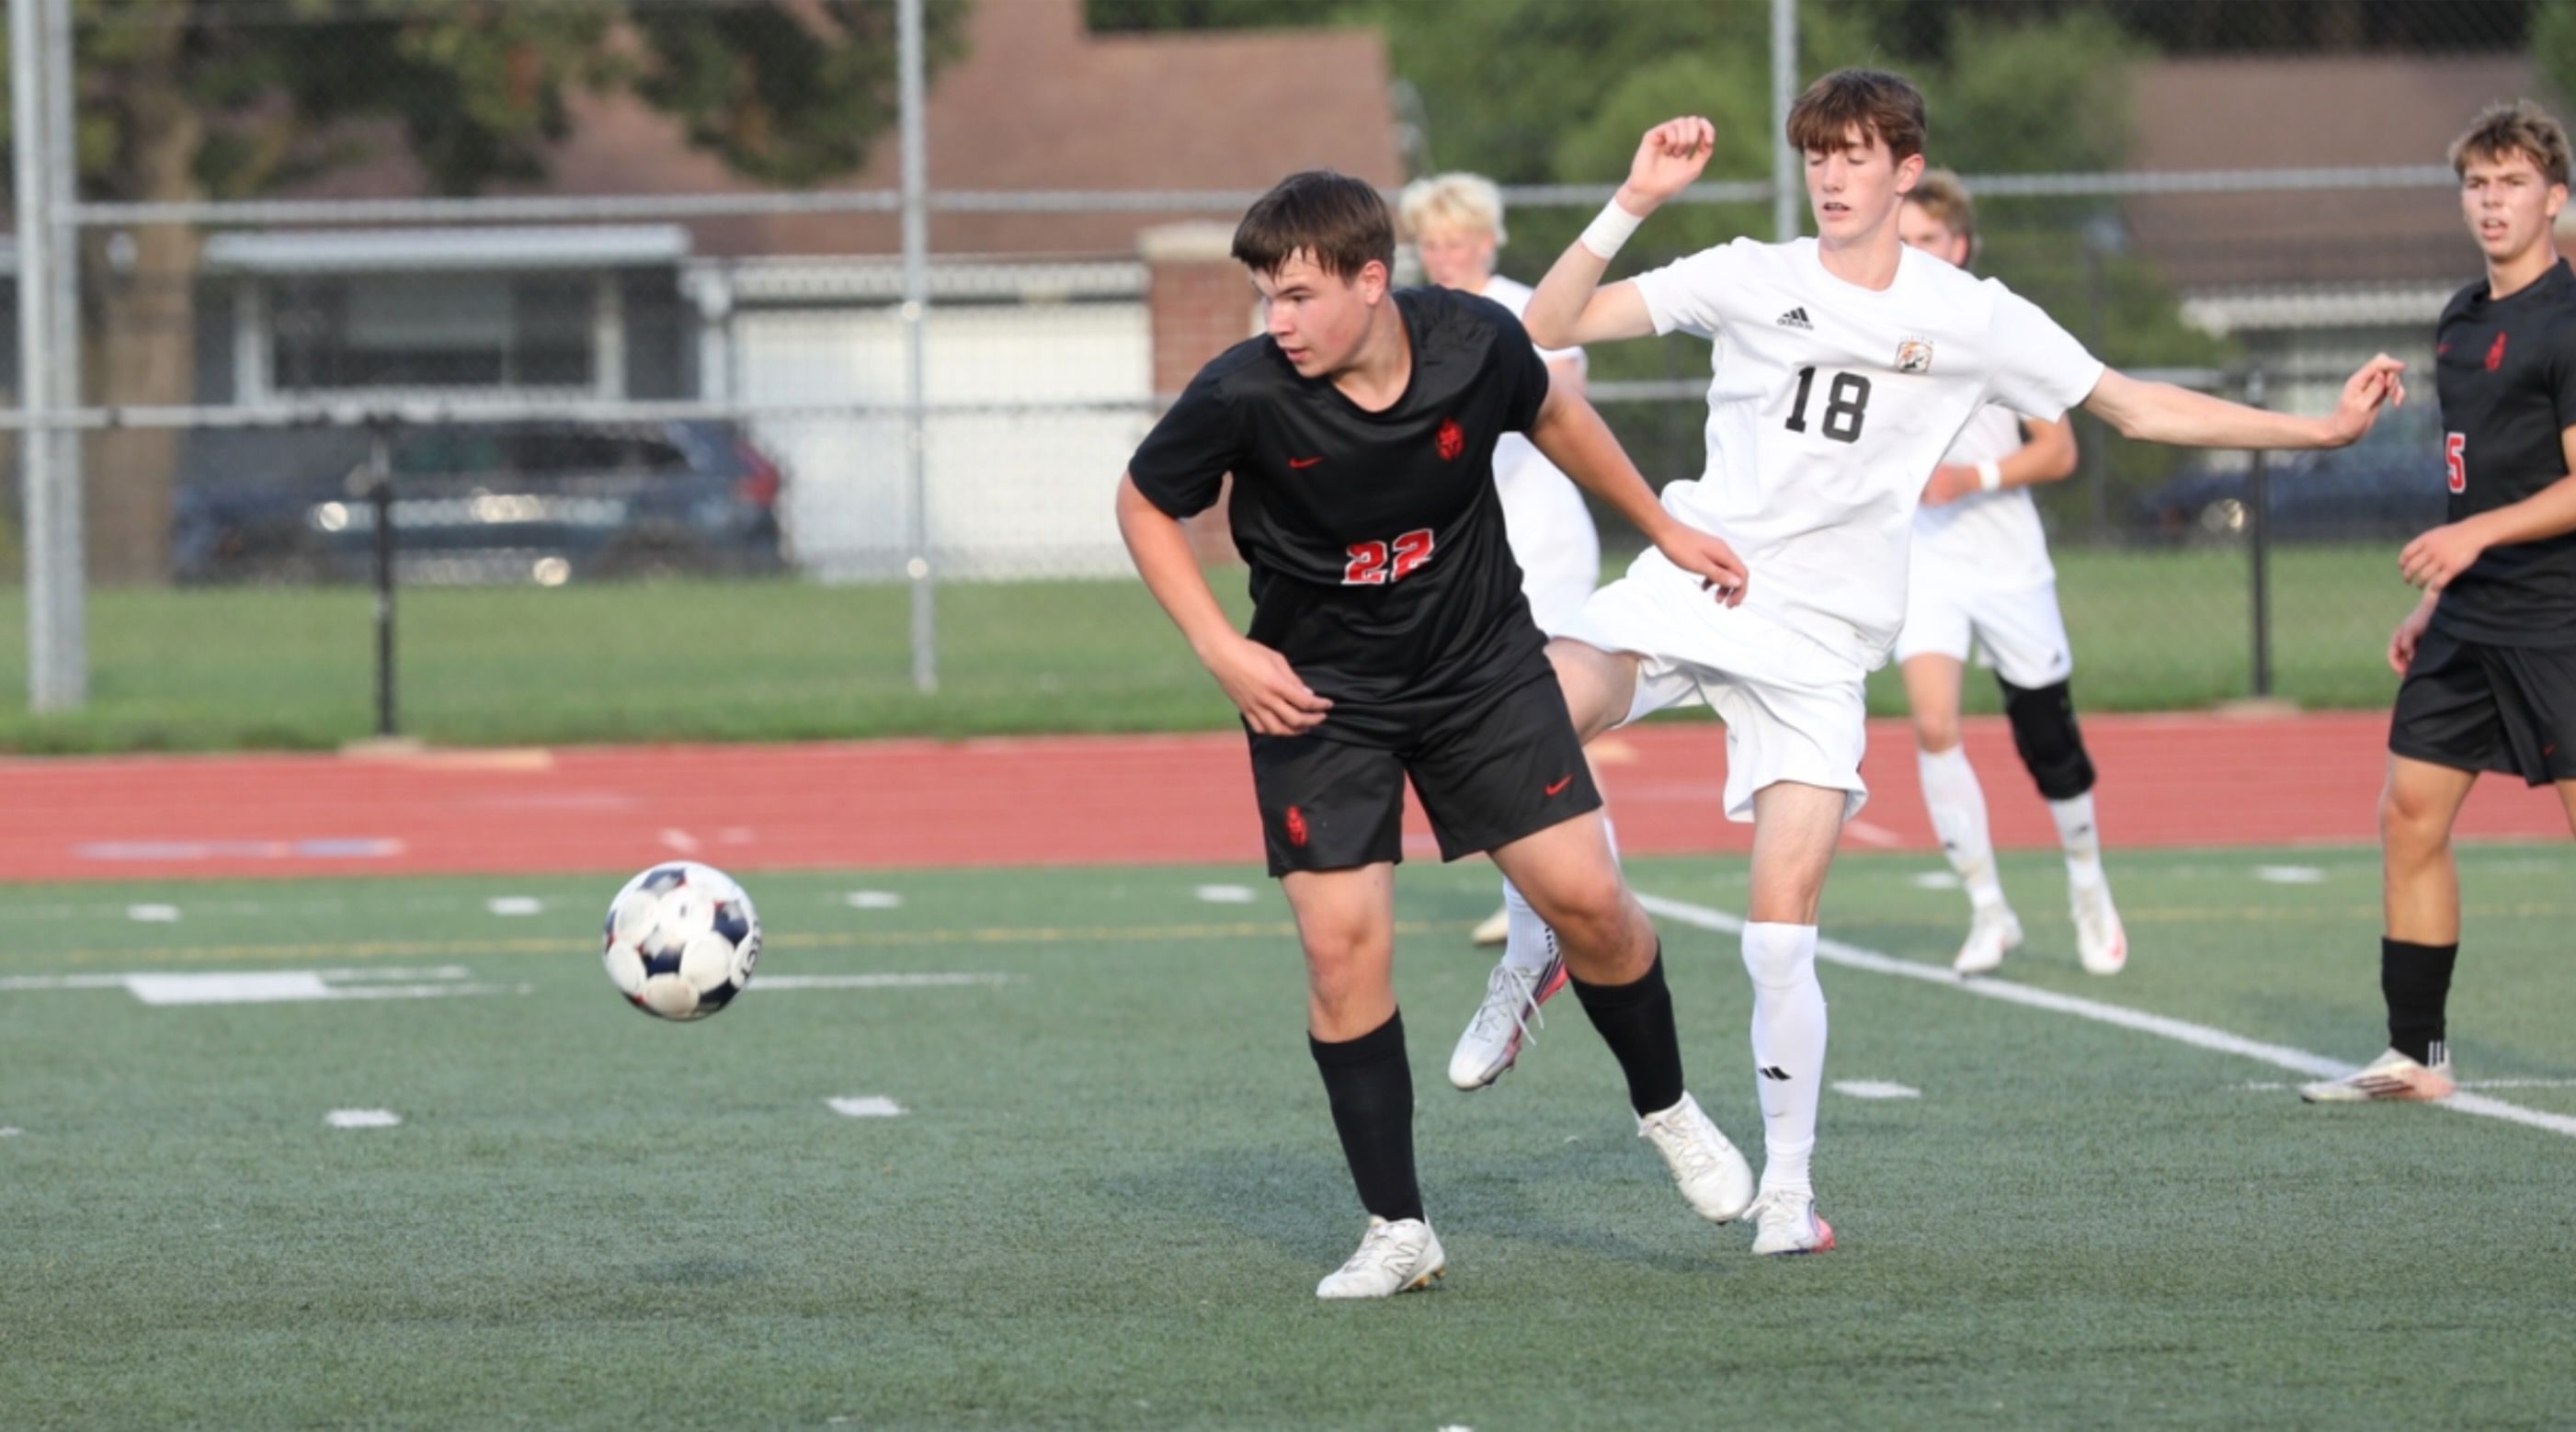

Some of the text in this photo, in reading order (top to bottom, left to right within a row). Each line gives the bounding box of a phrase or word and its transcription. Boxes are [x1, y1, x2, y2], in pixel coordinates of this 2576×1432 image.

[1784, 366, 1872, 444] 18
[2445, 431, 2467, 494] 5
[1340, 528, 1434, 585] 22
